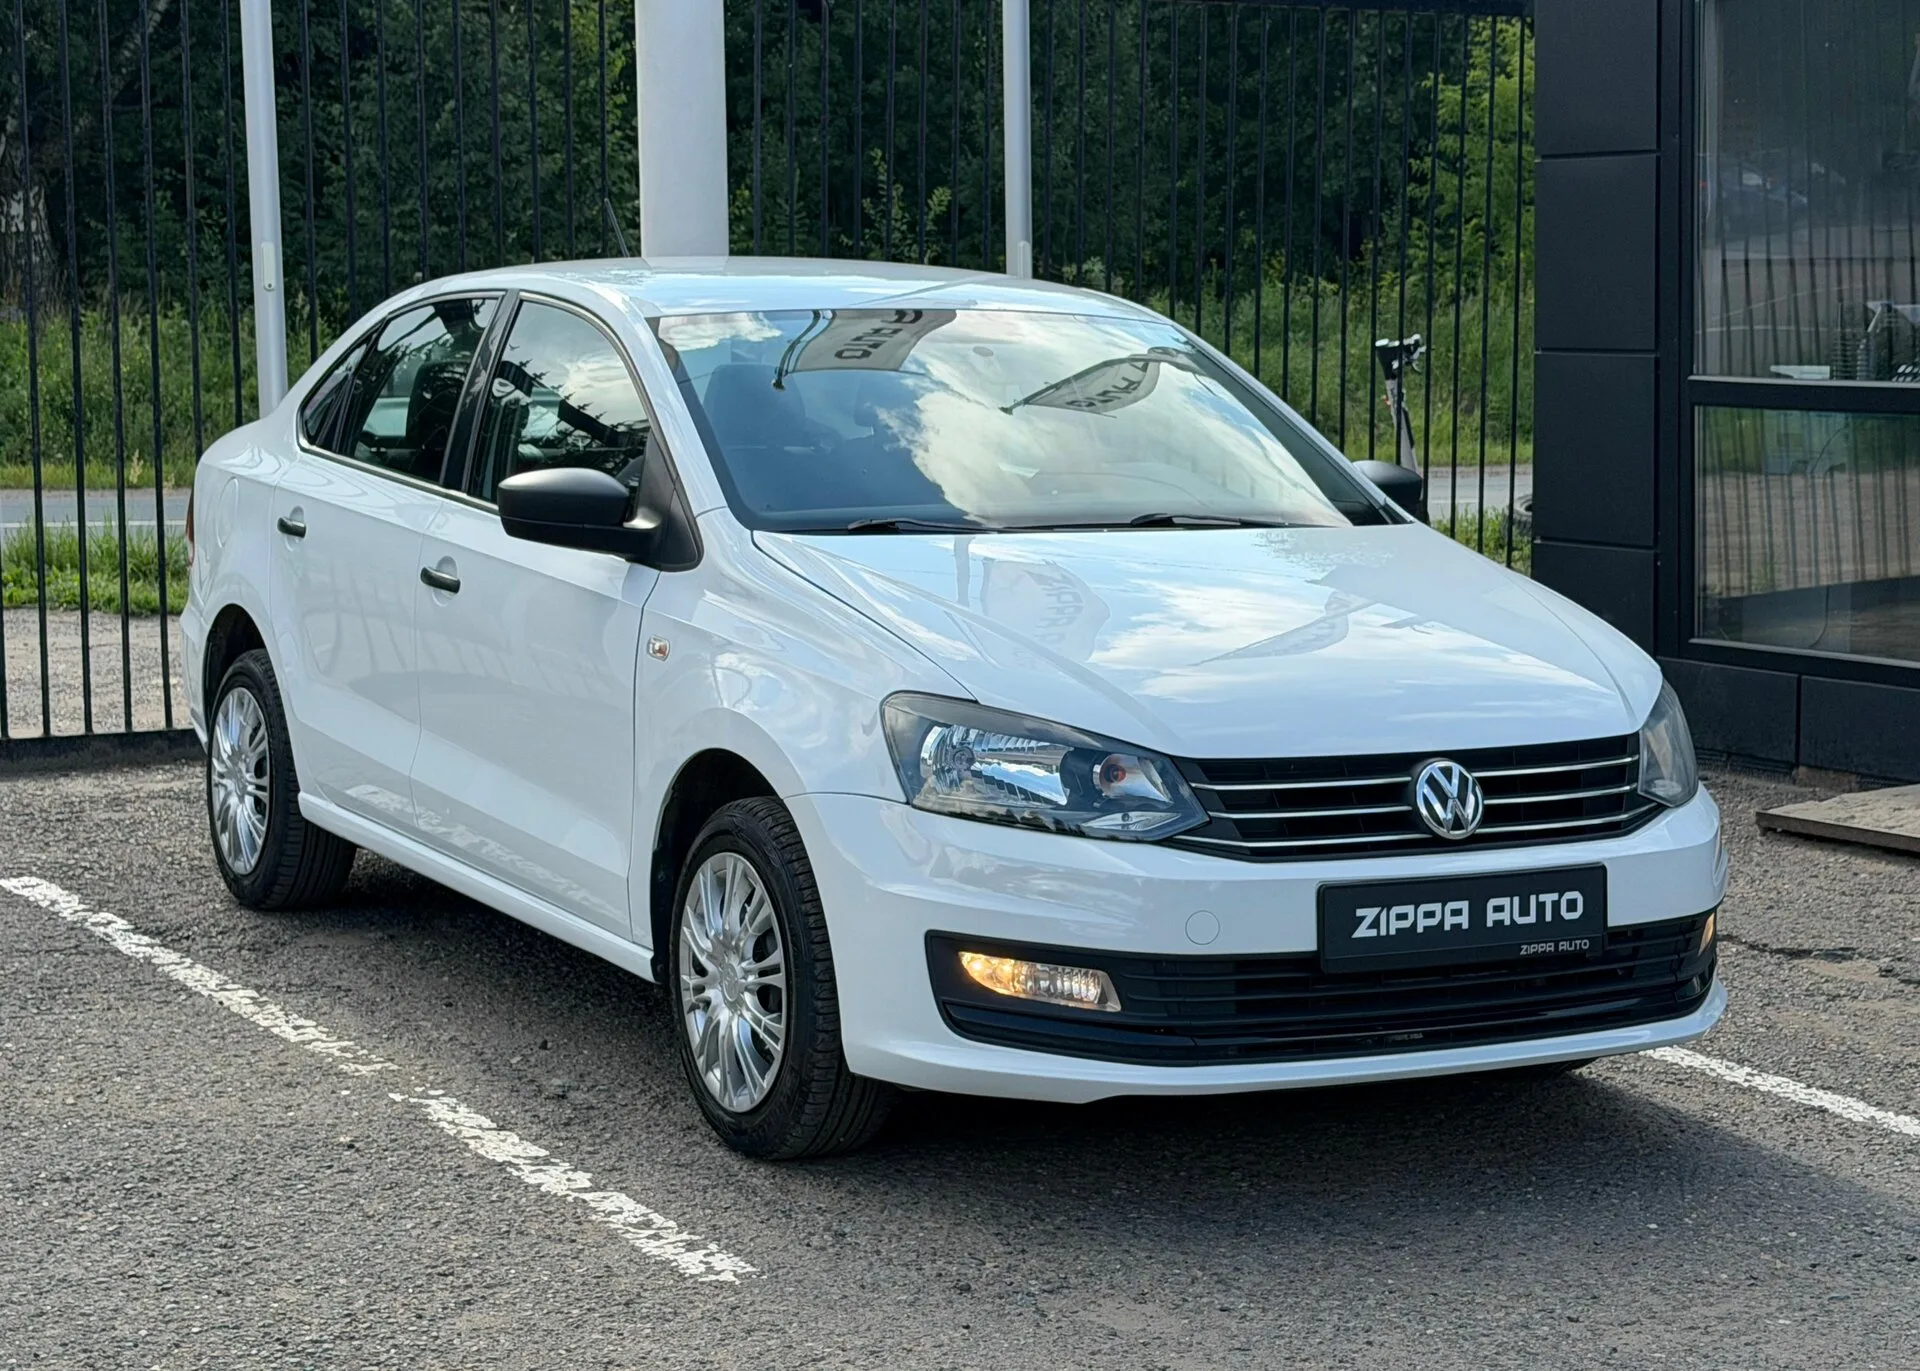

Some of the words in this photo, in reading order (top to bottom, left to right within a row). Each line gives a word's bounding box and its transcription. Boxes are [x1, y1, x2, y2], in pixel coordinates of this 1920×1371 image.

[1418, 762, 1480, 838] VW
[1351, 899, 1469, 938] ZIPPA
[1486, 890, 1584, 928] AUTO
[1520, 942, 1555, 955] ZIPPA
[1558, 939, 1590, 951] AUTO
